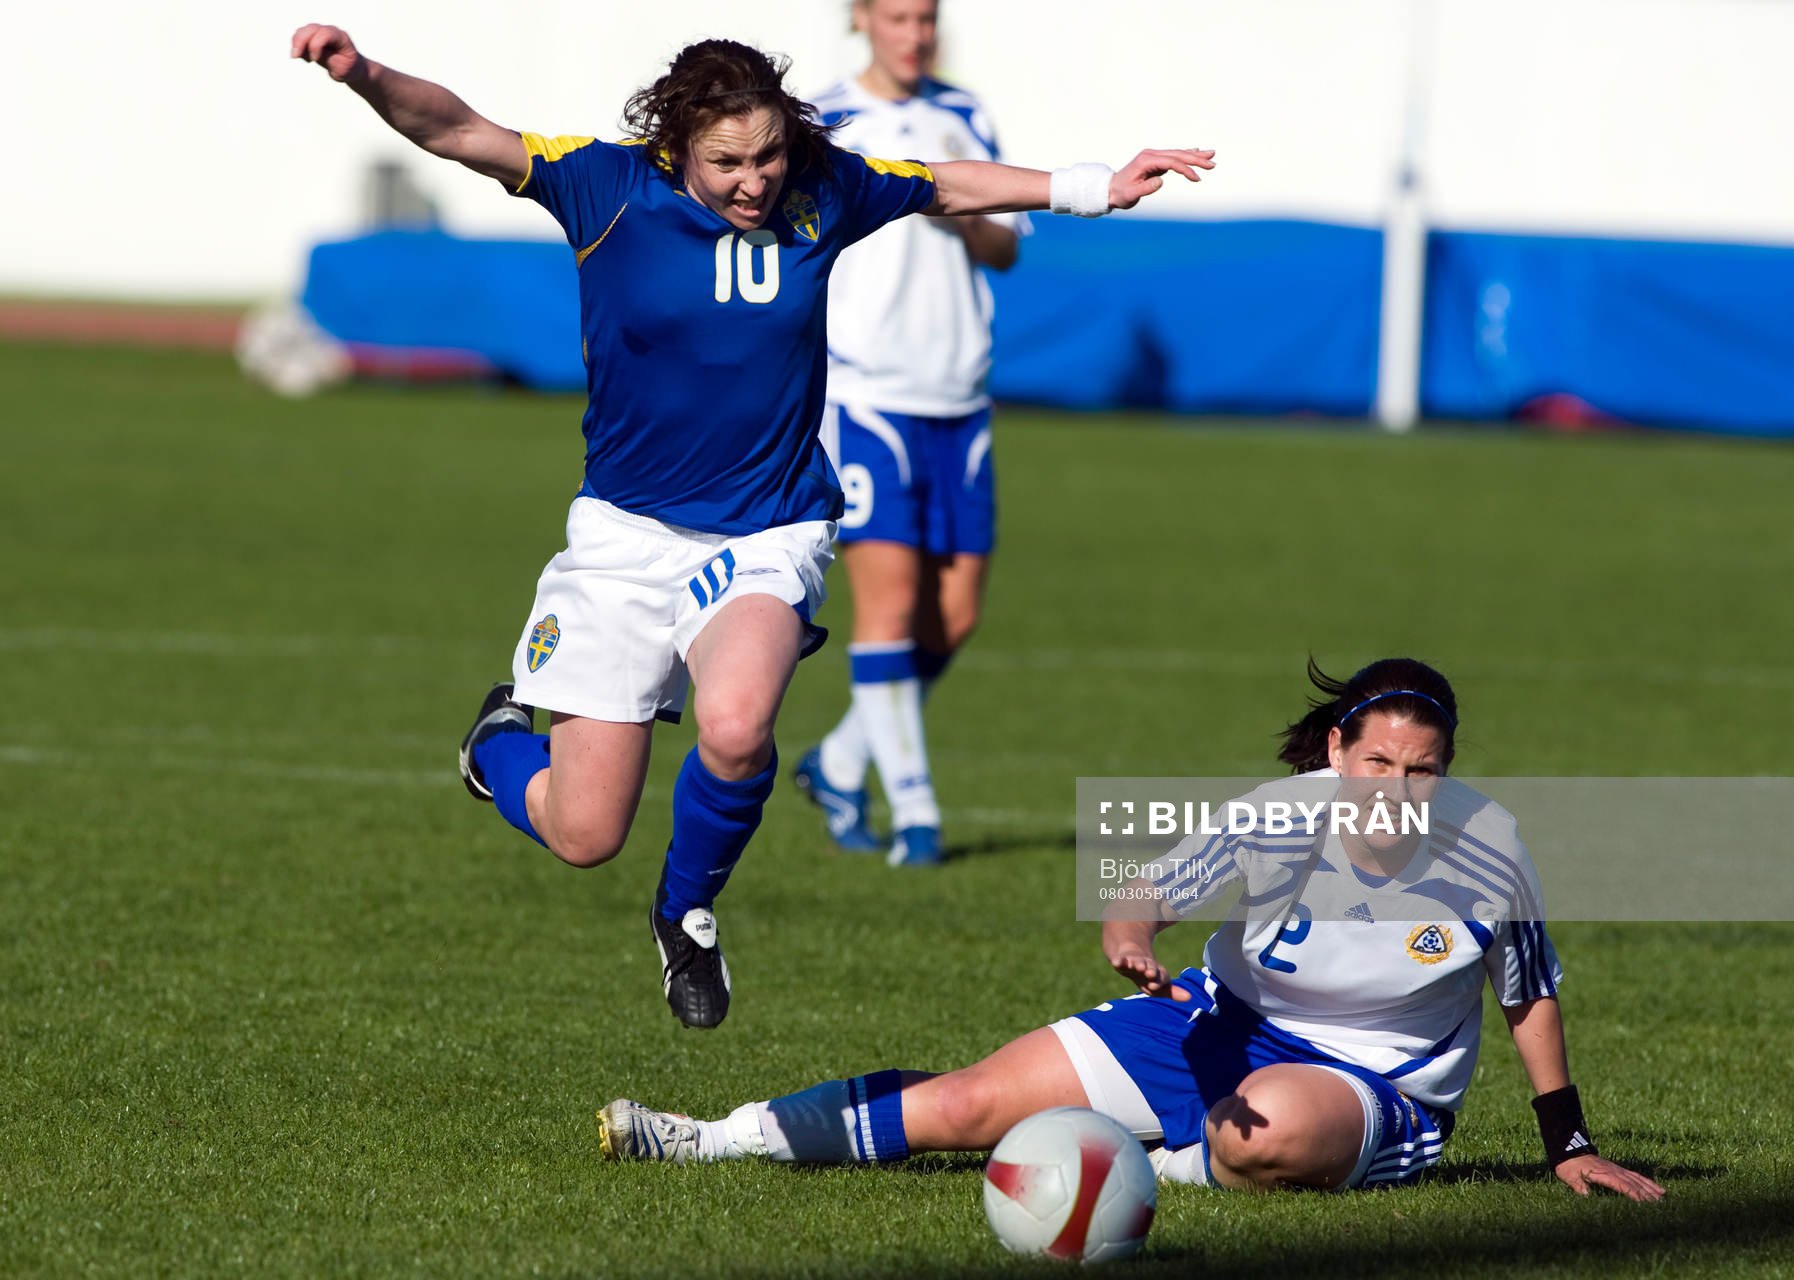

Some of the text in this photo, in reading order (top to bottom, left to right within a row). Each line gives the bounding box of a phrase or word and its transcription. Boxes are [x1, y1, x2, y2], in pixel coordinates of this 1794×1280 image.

[715, 230, 779, 303] 10
[840, 463, 873, 528] 9
[689, 548, 735, 610] 10
[1258, 902, 1312, 973] 2
